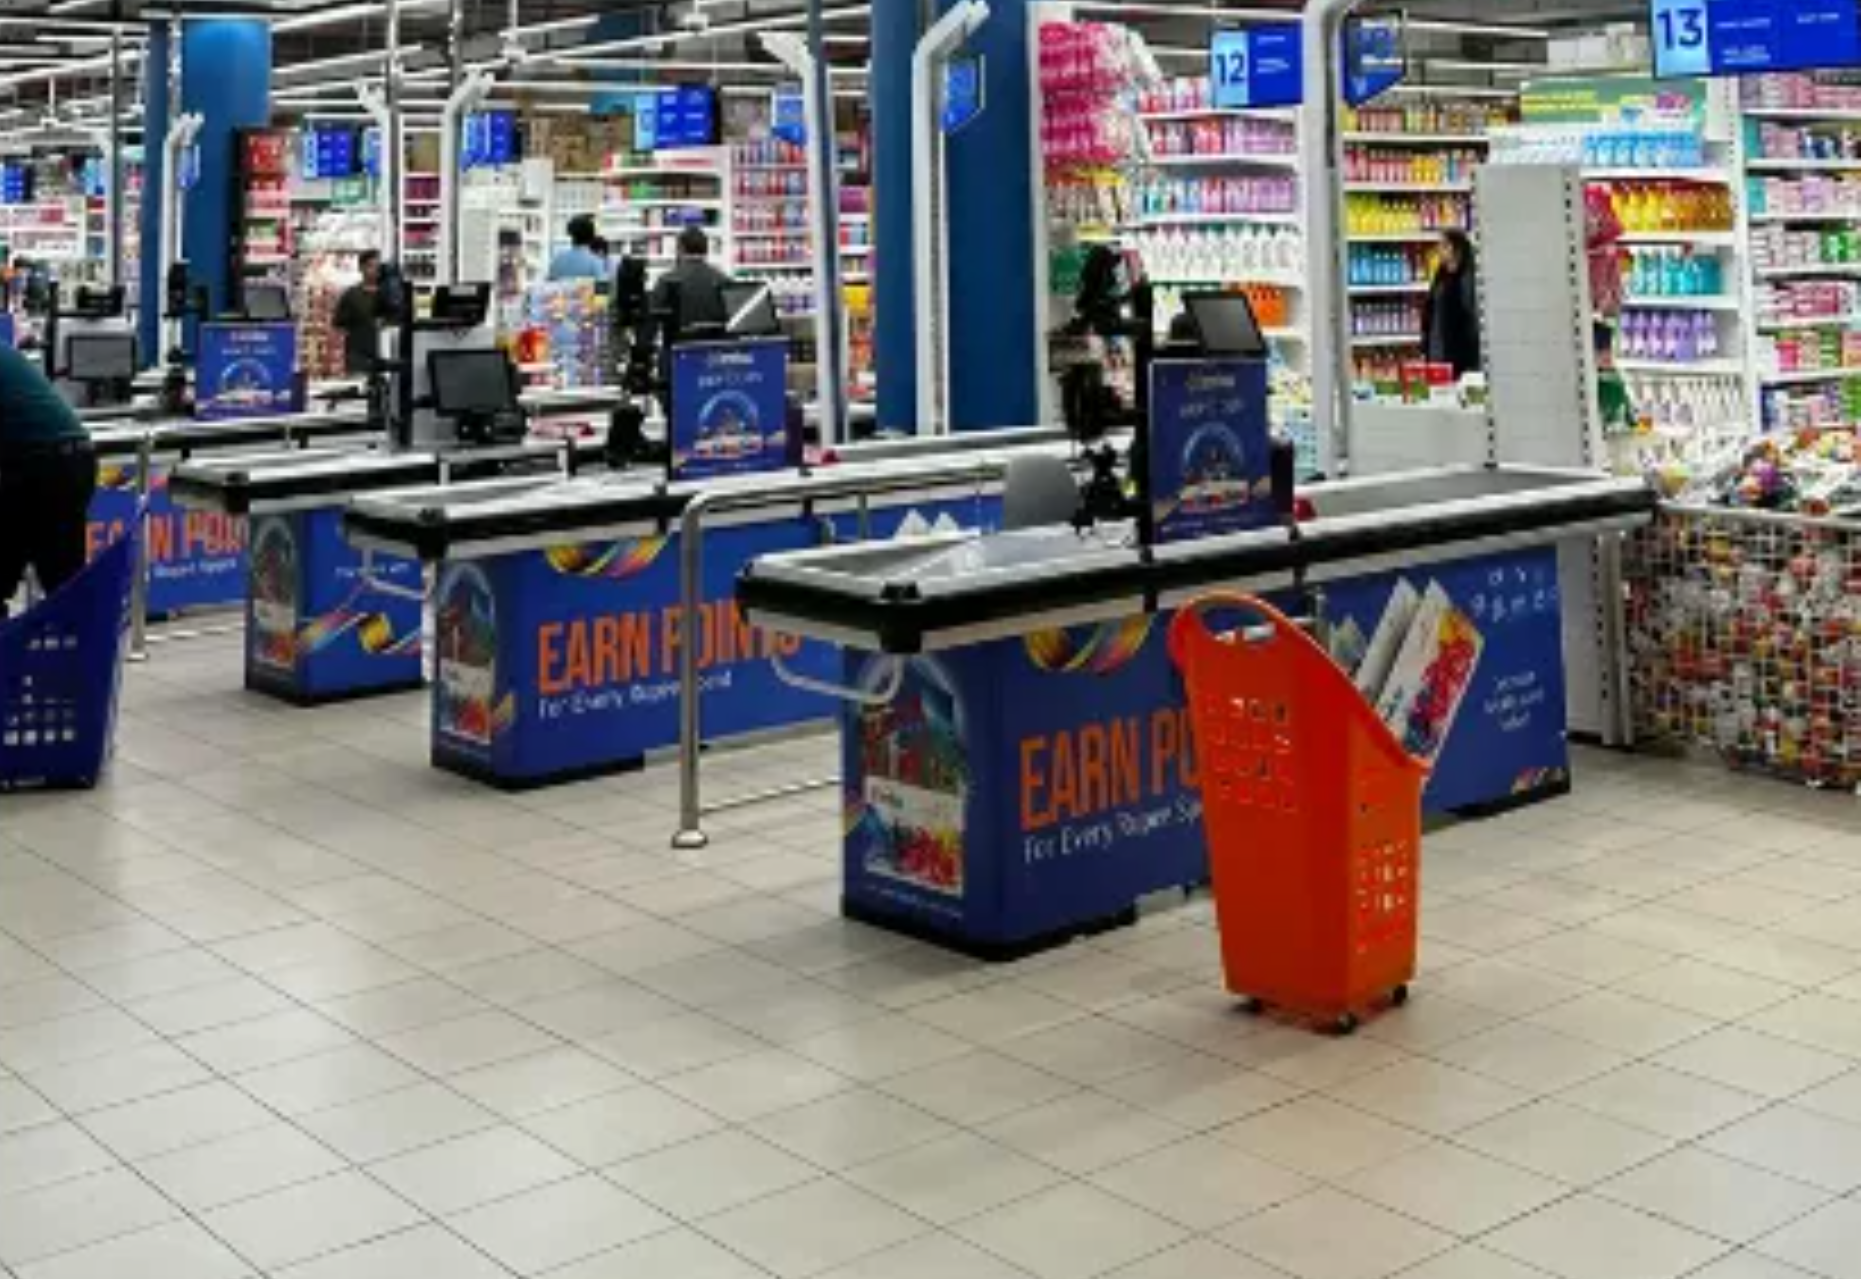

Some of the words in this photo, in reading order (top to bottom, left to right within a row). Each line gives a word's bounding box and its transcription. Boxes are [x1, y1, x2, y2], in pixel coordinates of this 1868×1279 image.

[1656, 7, 1704, 50] 13
[1215, 52, 1245, 86] 12
[538, 610, 651, 695] EARN
[1019, 715, 1142, 832] EARN
[1149, 707, 1202, 795] PO
[1173, 793, 1203, 828] Sp
